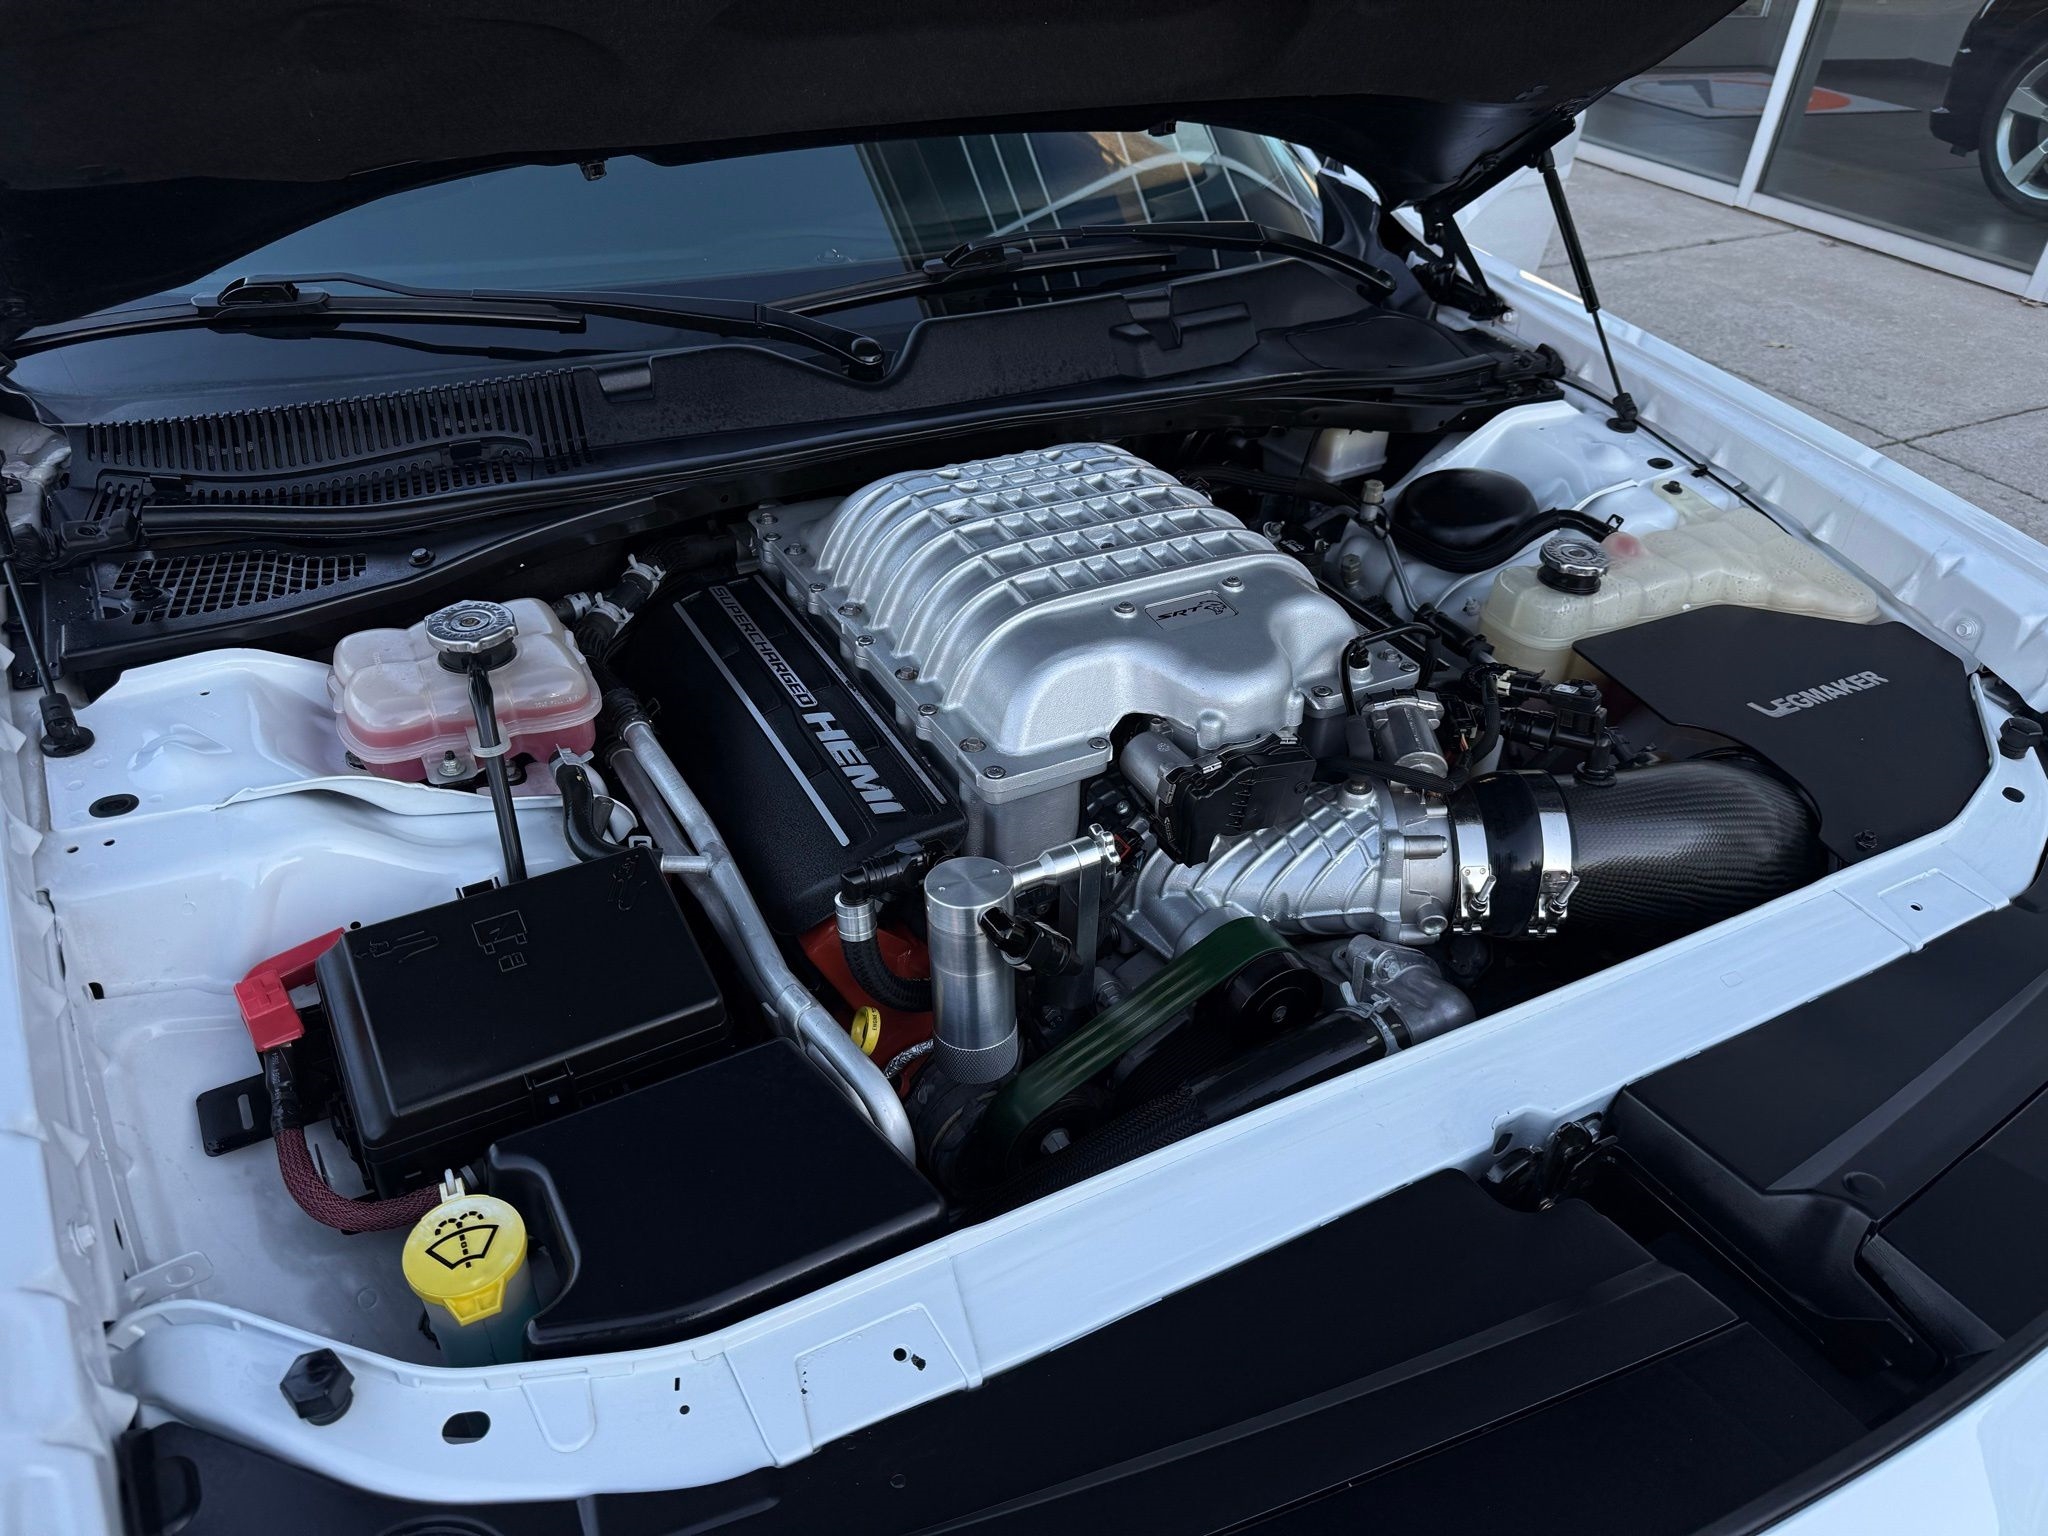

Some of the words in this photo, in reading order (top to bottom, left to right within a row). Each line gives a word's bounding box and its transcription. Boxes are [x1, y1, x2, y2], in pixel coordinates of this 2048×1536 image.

[710, 586, 817, 707] SUPERCHARGED
[1157, 606, 1200, 620] SRT
[1747, 670, 1889, 718] LEGMAKER
[803, 712, 905, 814] HEMI
